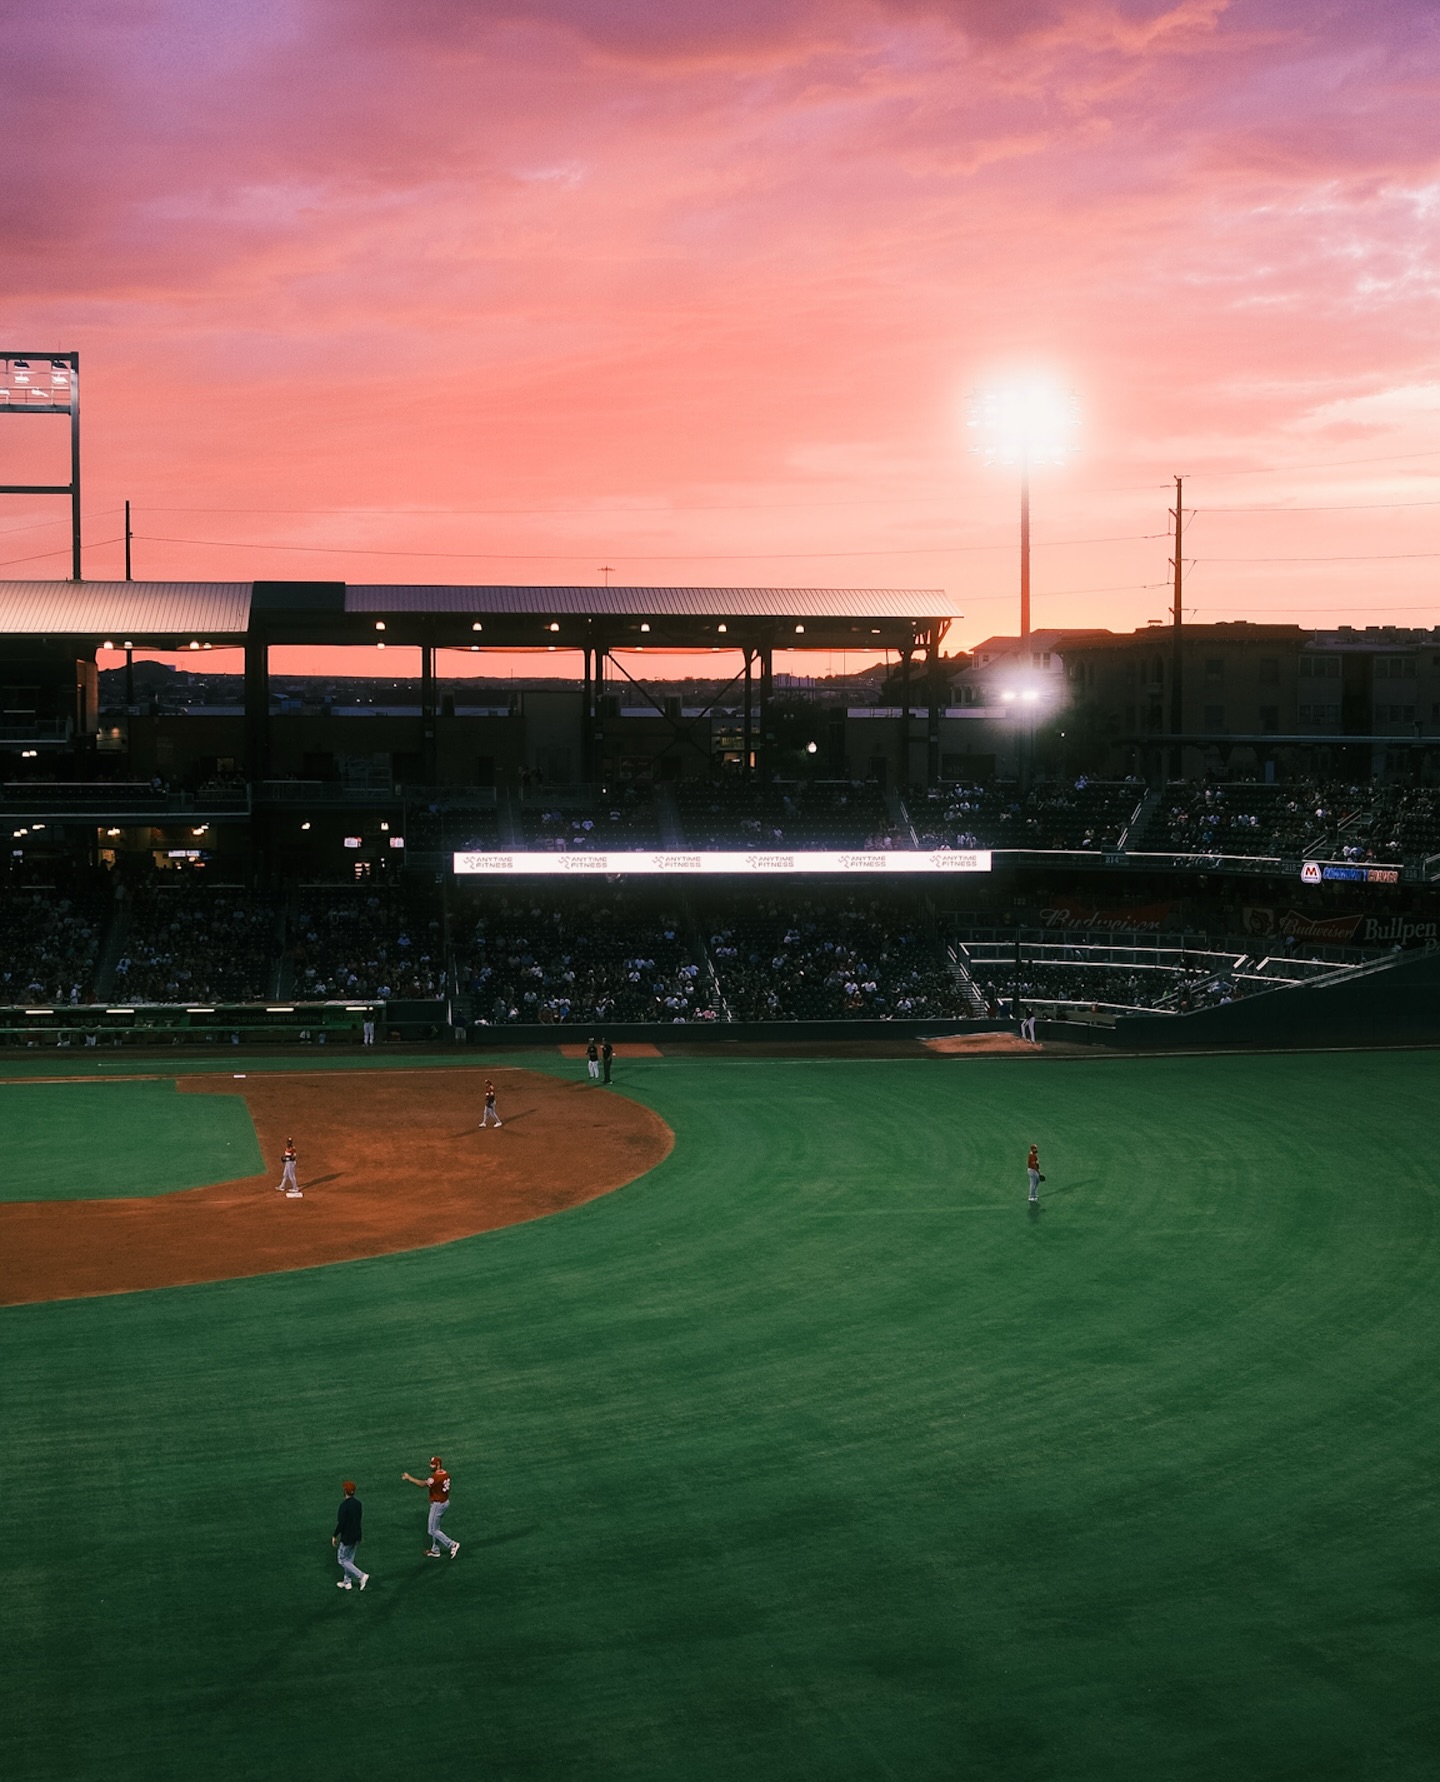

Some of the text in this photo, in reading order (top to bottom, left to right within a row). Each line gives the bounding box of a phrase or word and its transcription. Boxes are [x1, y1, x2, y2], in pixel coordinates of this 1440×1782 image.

[1040, 908, 1160, 931] Budweiser
[1280, 916, 1438, 946] Budweiser Bullpen
